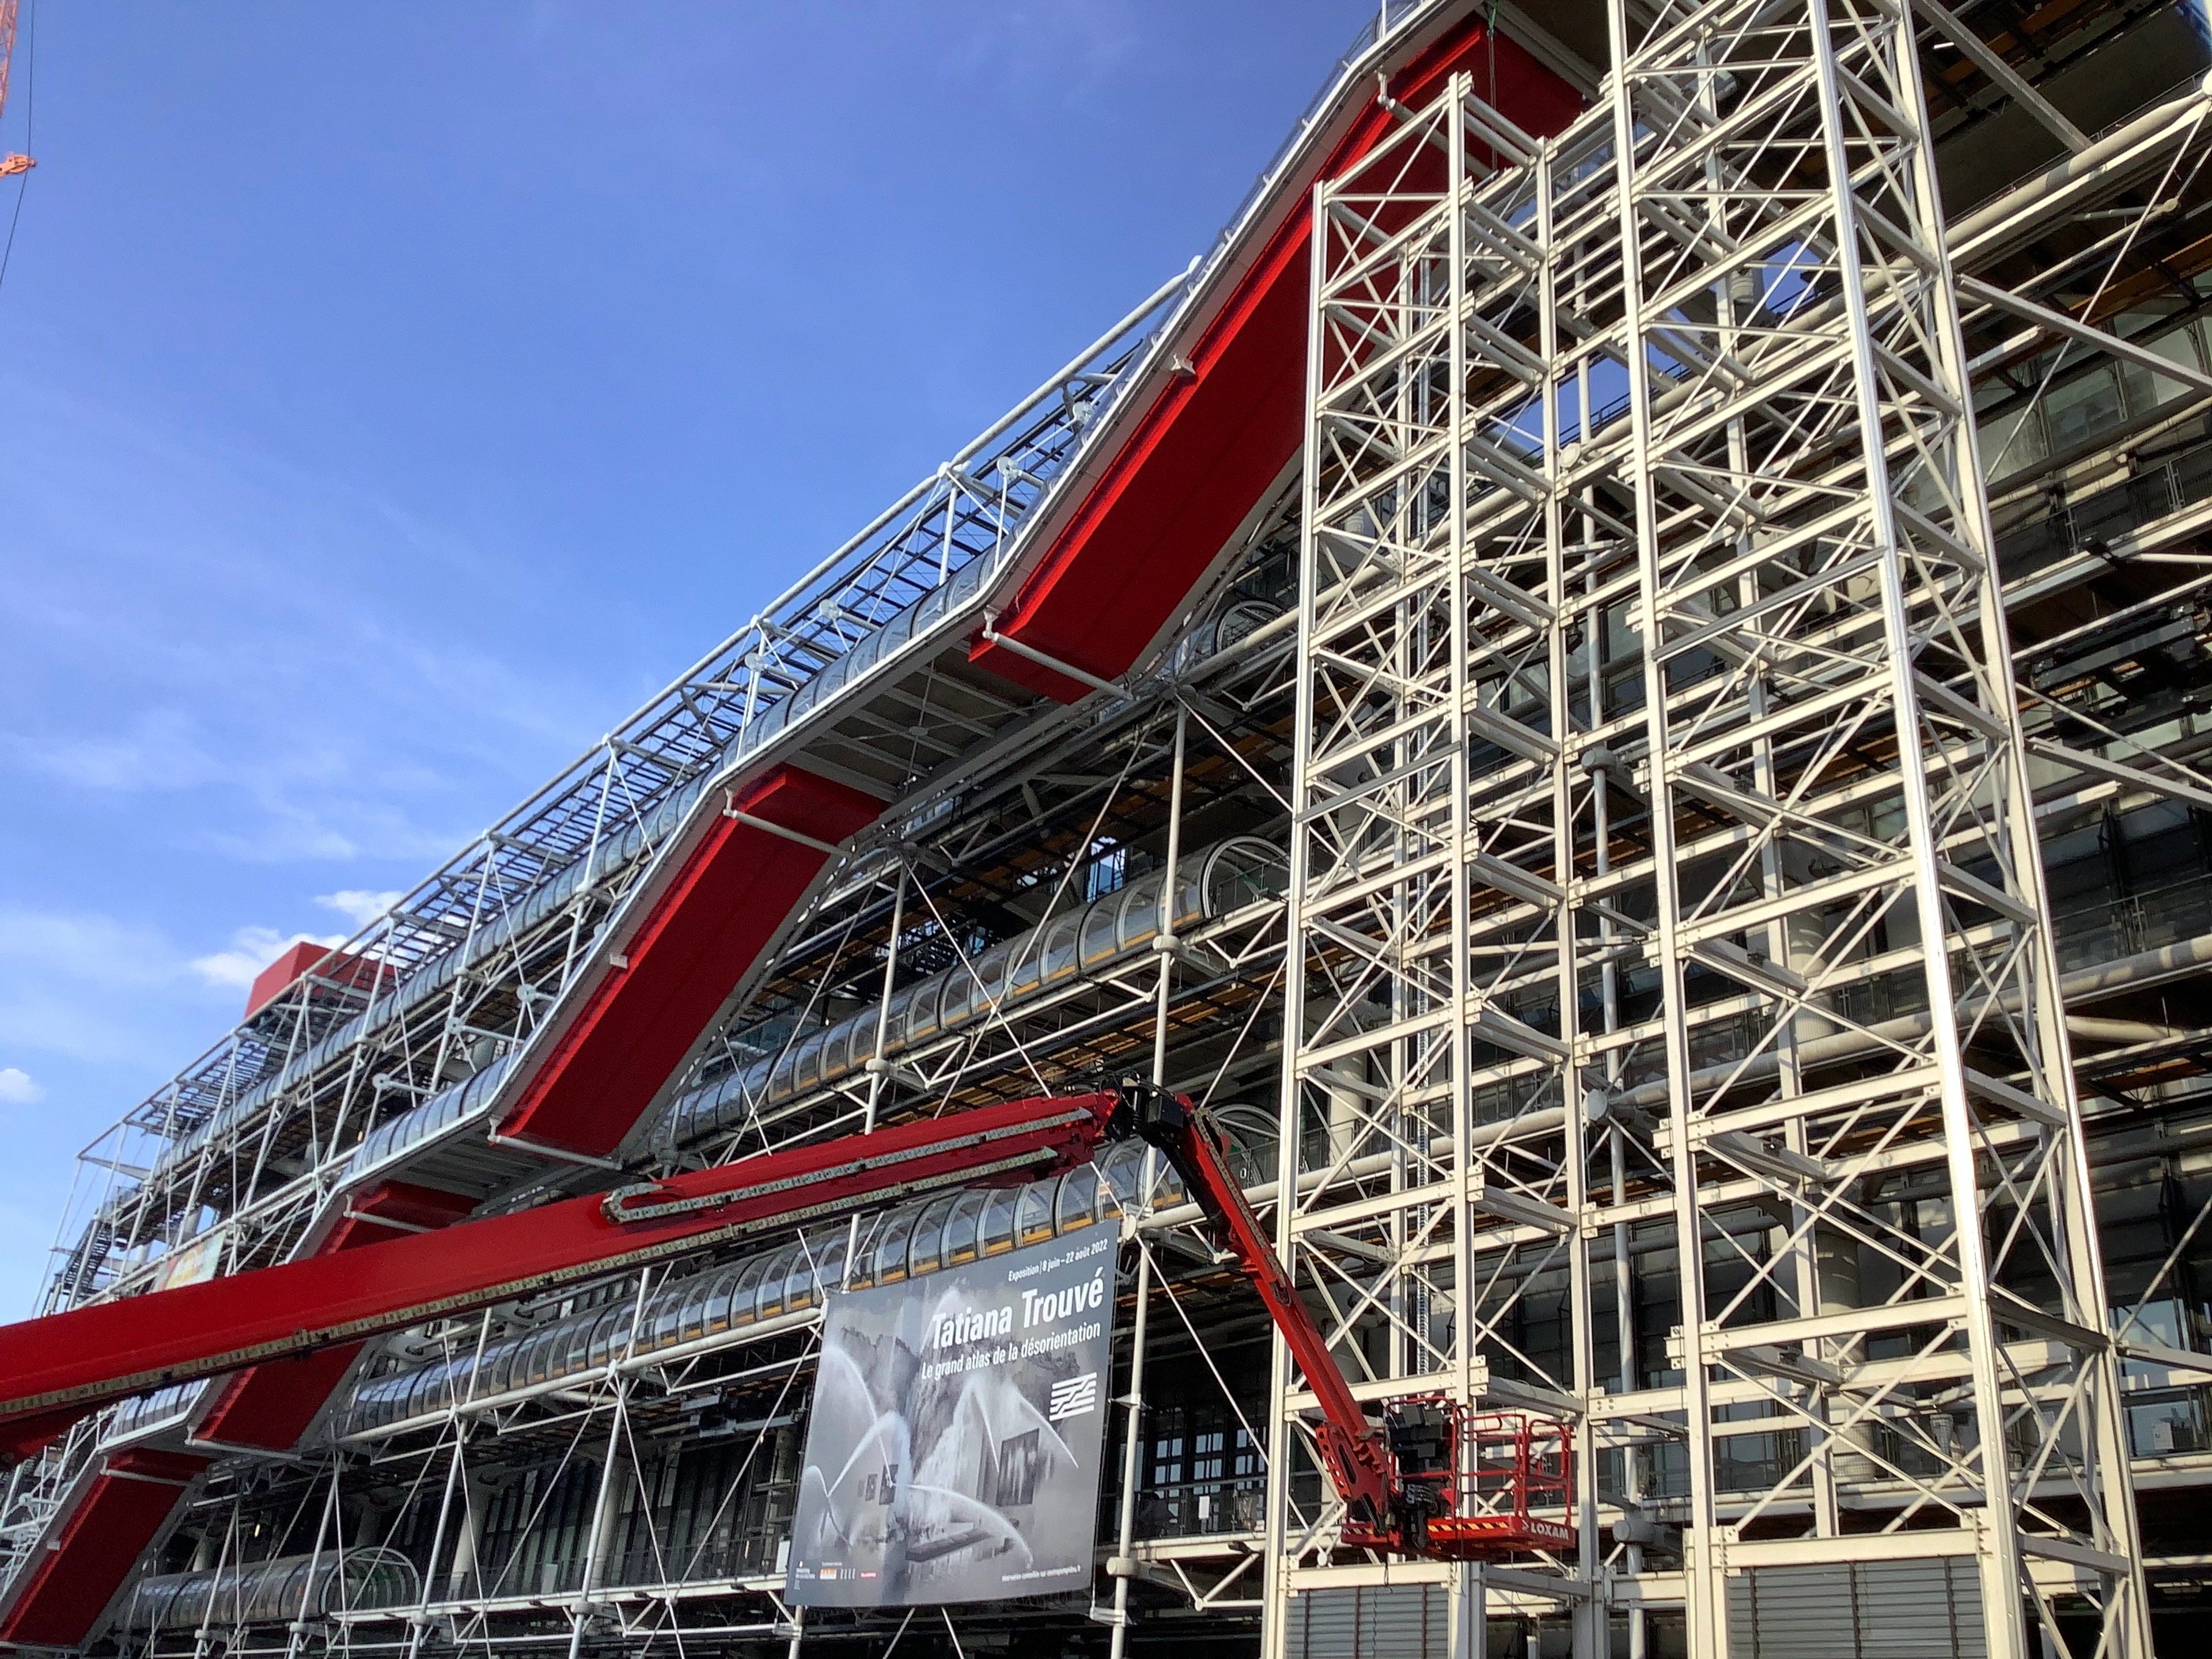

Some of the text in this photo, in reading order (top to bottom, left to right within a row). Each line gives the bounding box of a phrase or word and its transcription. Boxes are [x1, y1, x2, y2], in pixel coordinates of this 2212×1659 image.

[1008, 1264, 1039, 1282] Exposition
[1042, 1260, 1047, 1272] 8
[1066, 1251, 1074, 1264] 22
[1075, 1246, 1090, 1260] août
[1091, 1238, 1108, 1255] 2022
[933, 1266, 1104, 1349] Tatiana Trouvé
[922, 1321, 1101, 1381] Le grand atlas de la désorientation
[1531, 1521, 1569, 1540] LOXAM
